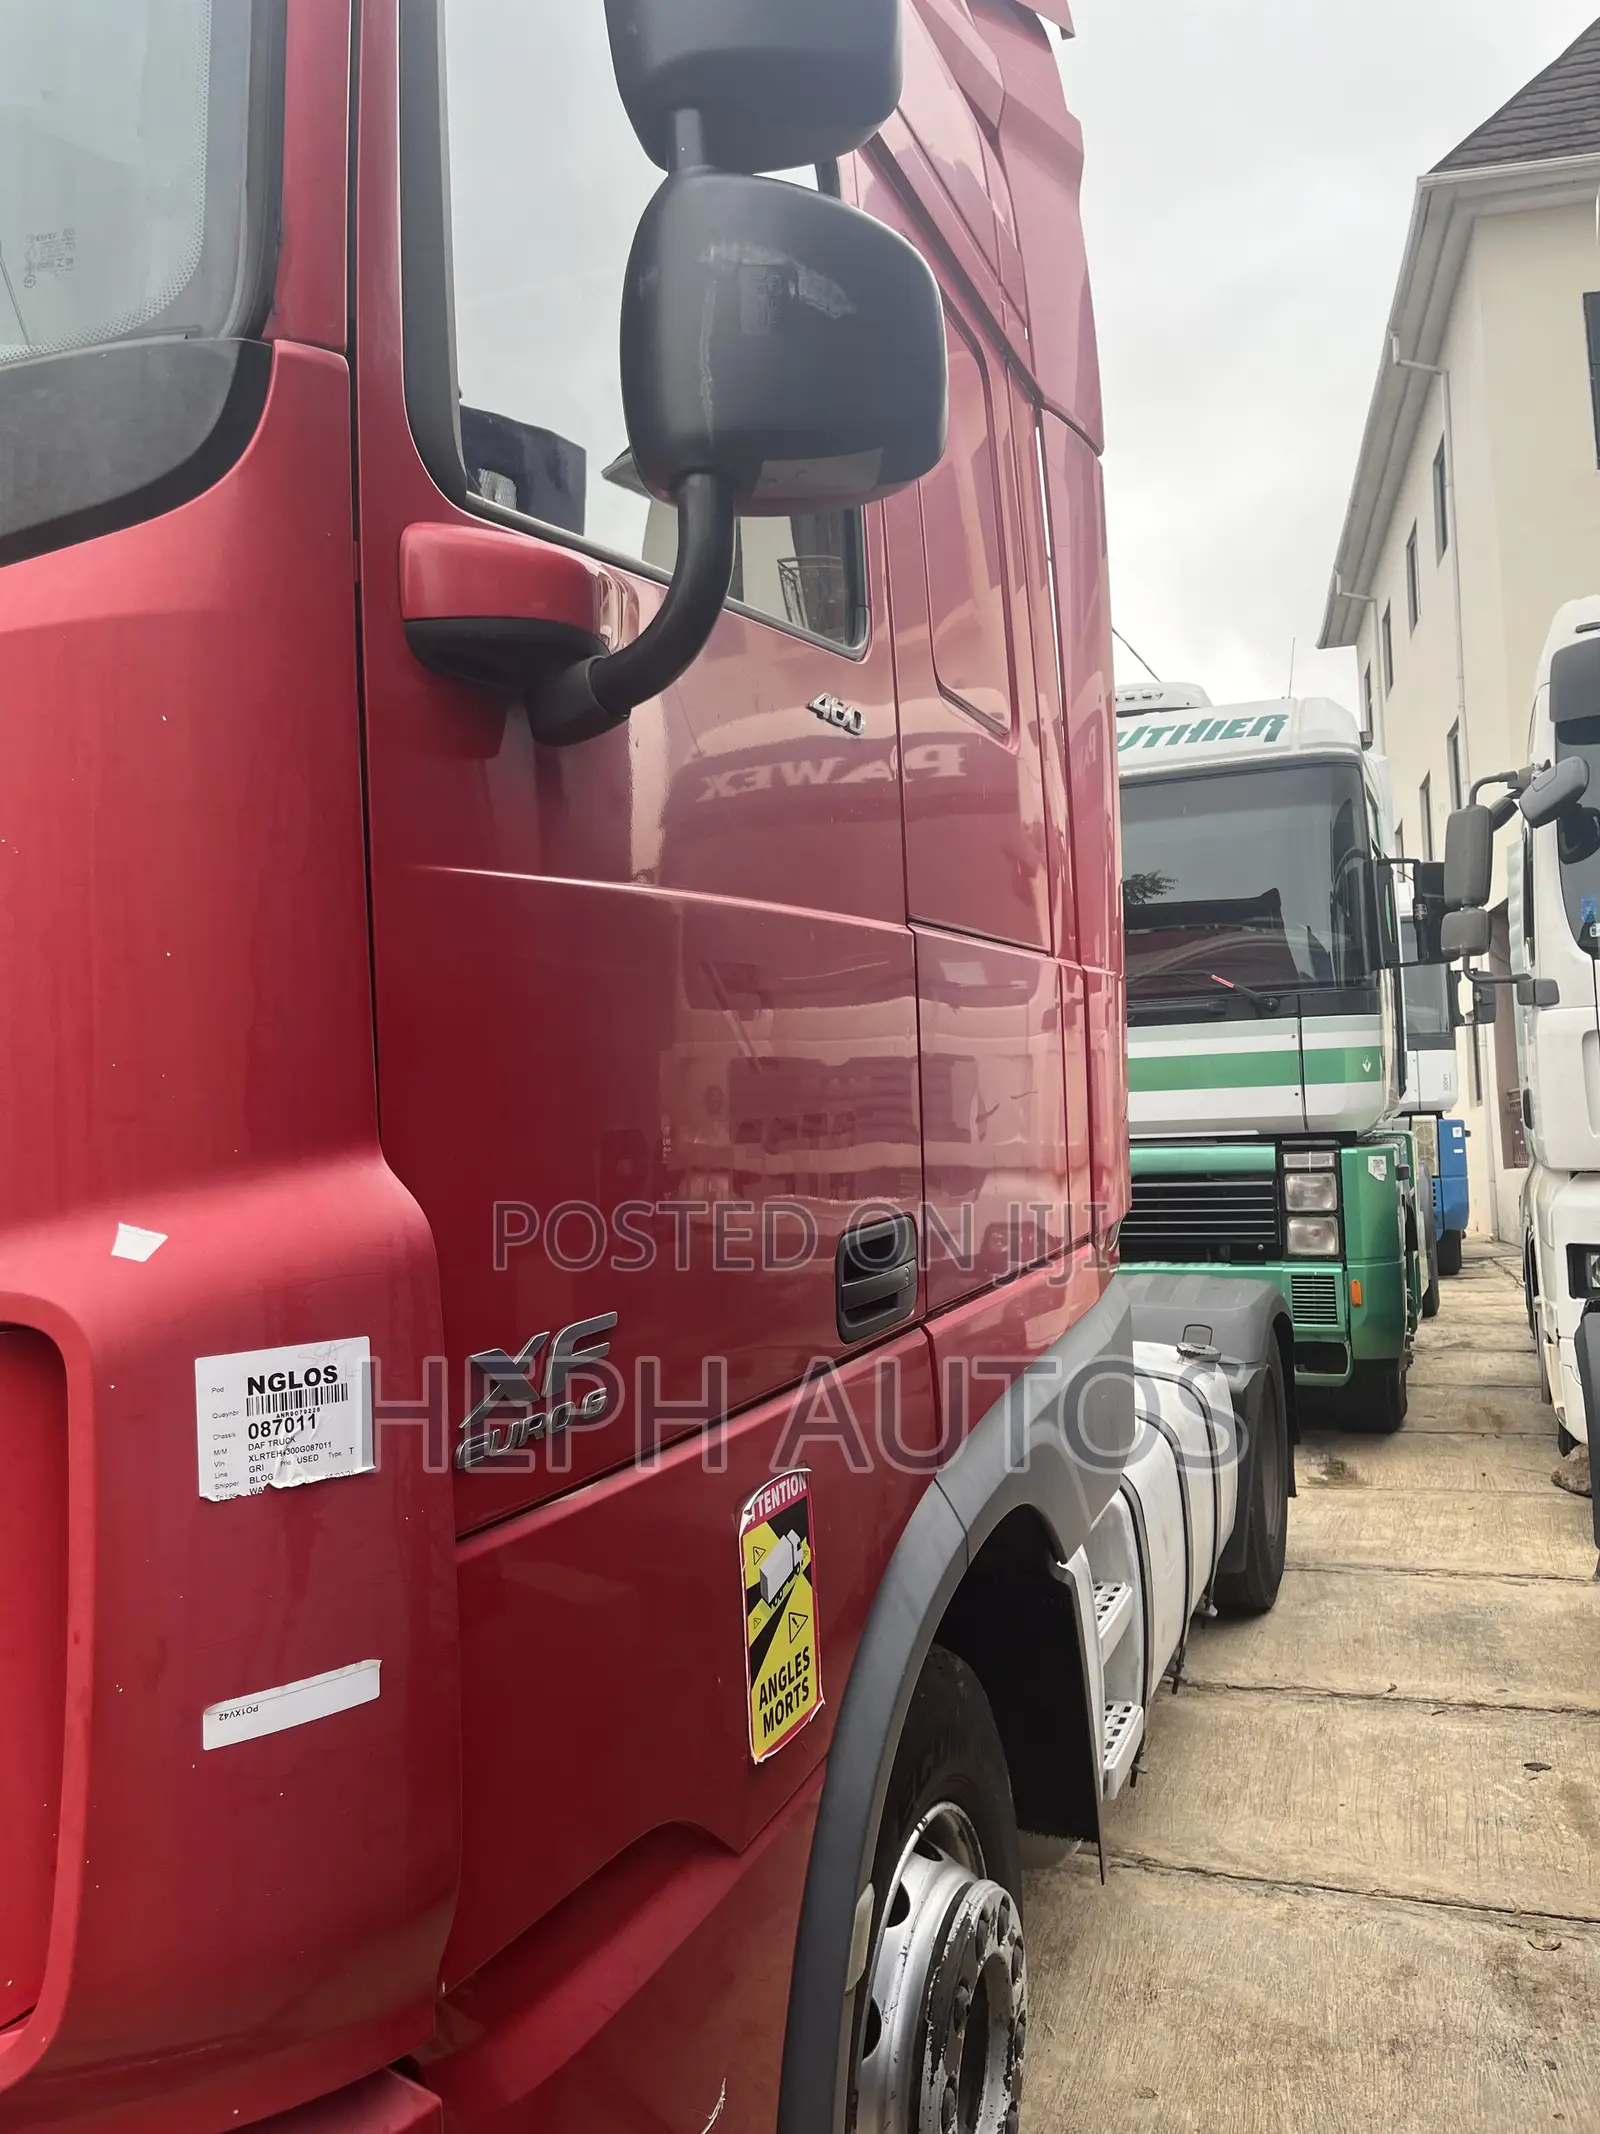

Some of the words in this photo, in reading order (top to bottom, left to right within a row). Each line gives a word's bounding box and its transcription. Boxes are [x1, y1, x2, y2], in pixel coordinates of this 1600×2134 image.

[211, 1386, 225, 1394] Pod
[247, 1365, 339, 1396] NGLOS
[459, 1311, 618, 1428] XF
[212, 1432, 237, 1441] Chassis
[248, 1413, 316, 1440] 087011
[248, 1441, 266, 1451] DAF
[268, 1435, 296, 1447] TRUCK
[455, 1401, 577, 1469] EURO
[581, 1387, 608, 1419] 6
[214, 1471, 229, 1479] Line
[248, 1464, 264, 1474] GRI
[297, 1454, 320, 1464] USED
[348, 1446, 354, 1455] T
[214, 1481, 240, 1490] Shipper
[249, 1473, 274, 1485] BLOG
[758, 1645, 811, 1712] ANGLES
[762, 1676, 810, 1738] MORTS
